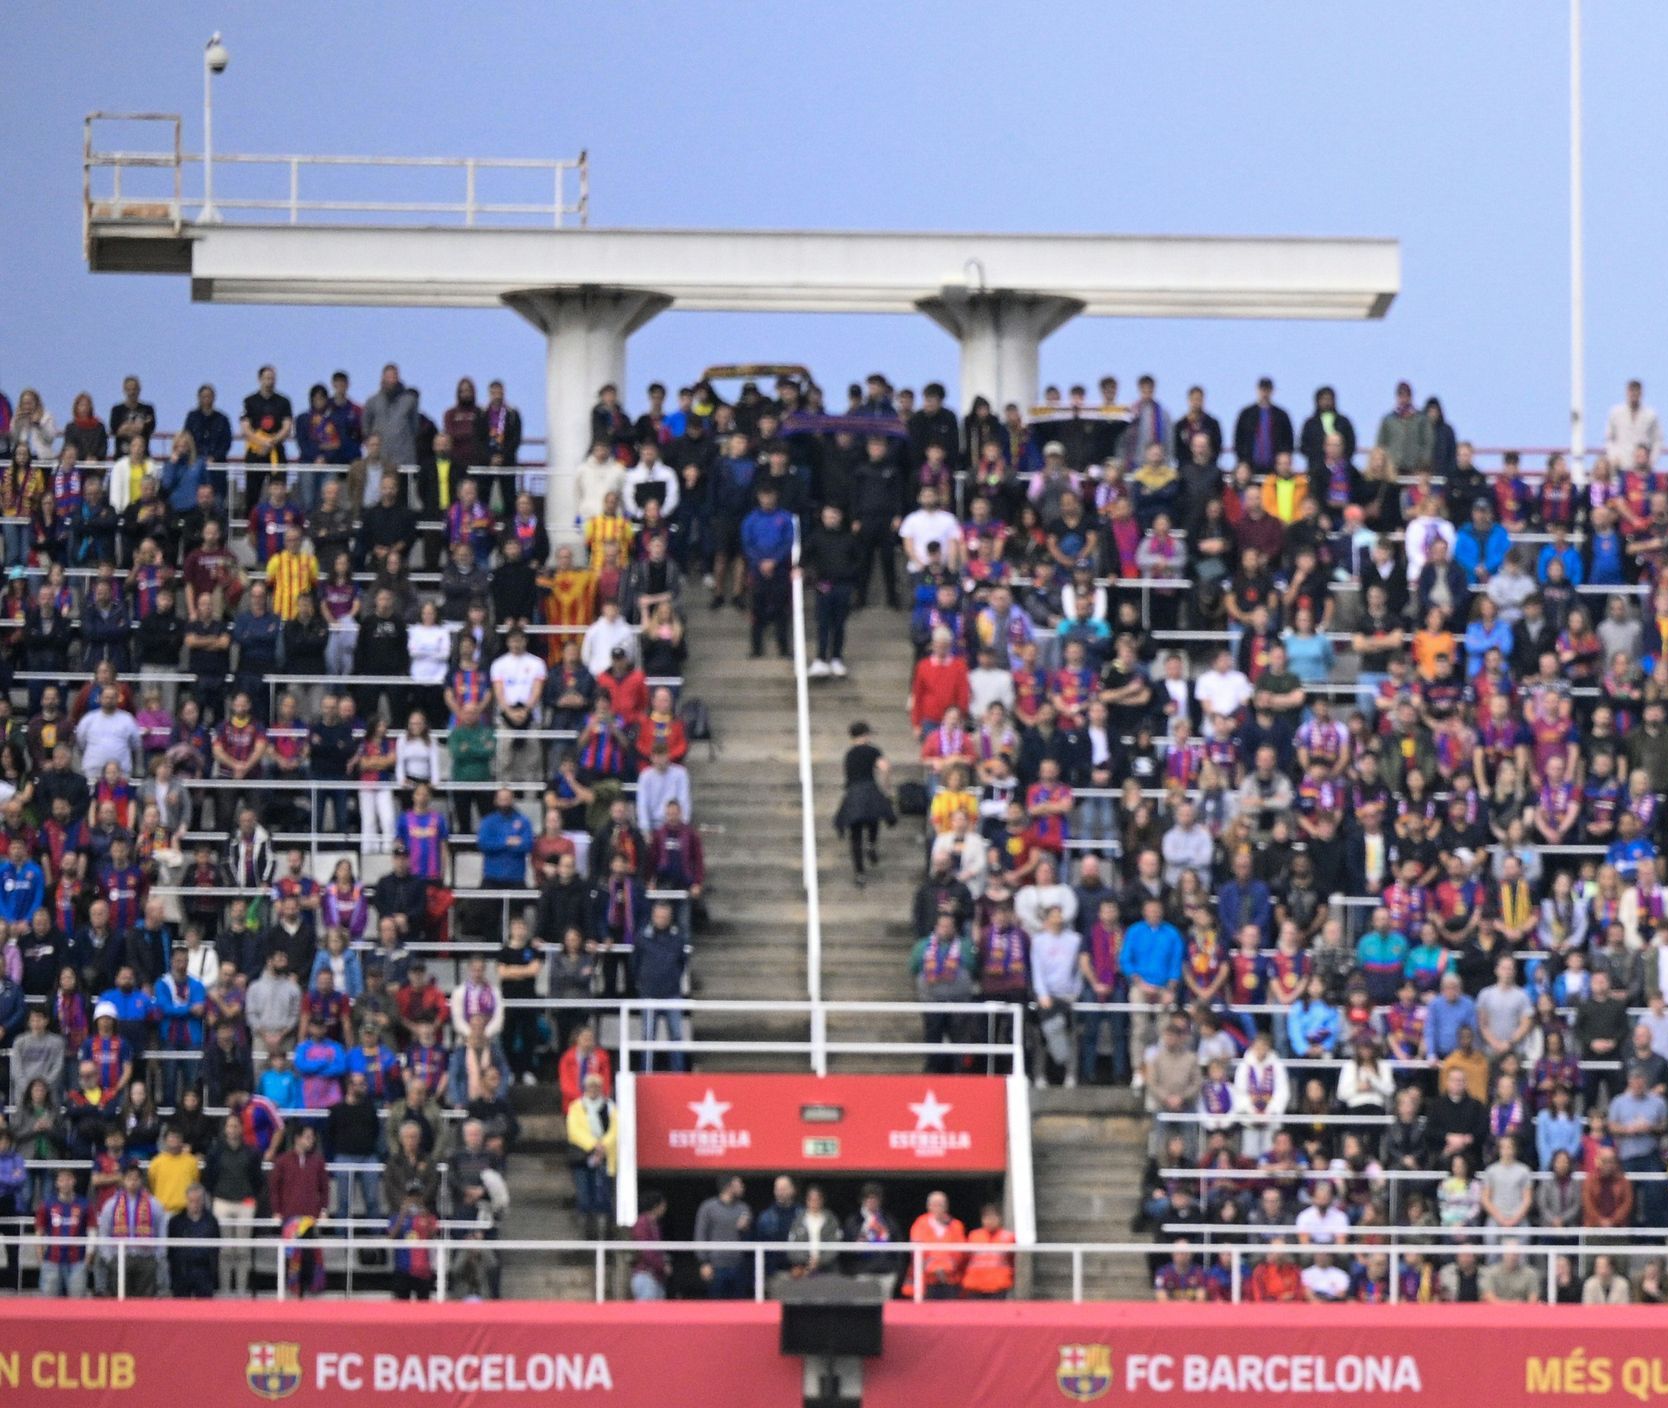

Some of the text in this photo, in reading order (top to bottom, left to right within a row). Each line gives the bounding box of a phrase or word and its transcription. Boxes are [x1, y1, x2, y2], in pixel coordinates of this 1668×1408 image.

[32, 1353, 136, 1389] CLUB
[316, 1353, 613, 1392] FC BARCELONA
[1126, 1354, 1421, 1392] FC BARCELONA
[1526, 1347, 1612, 1393] MÉS
